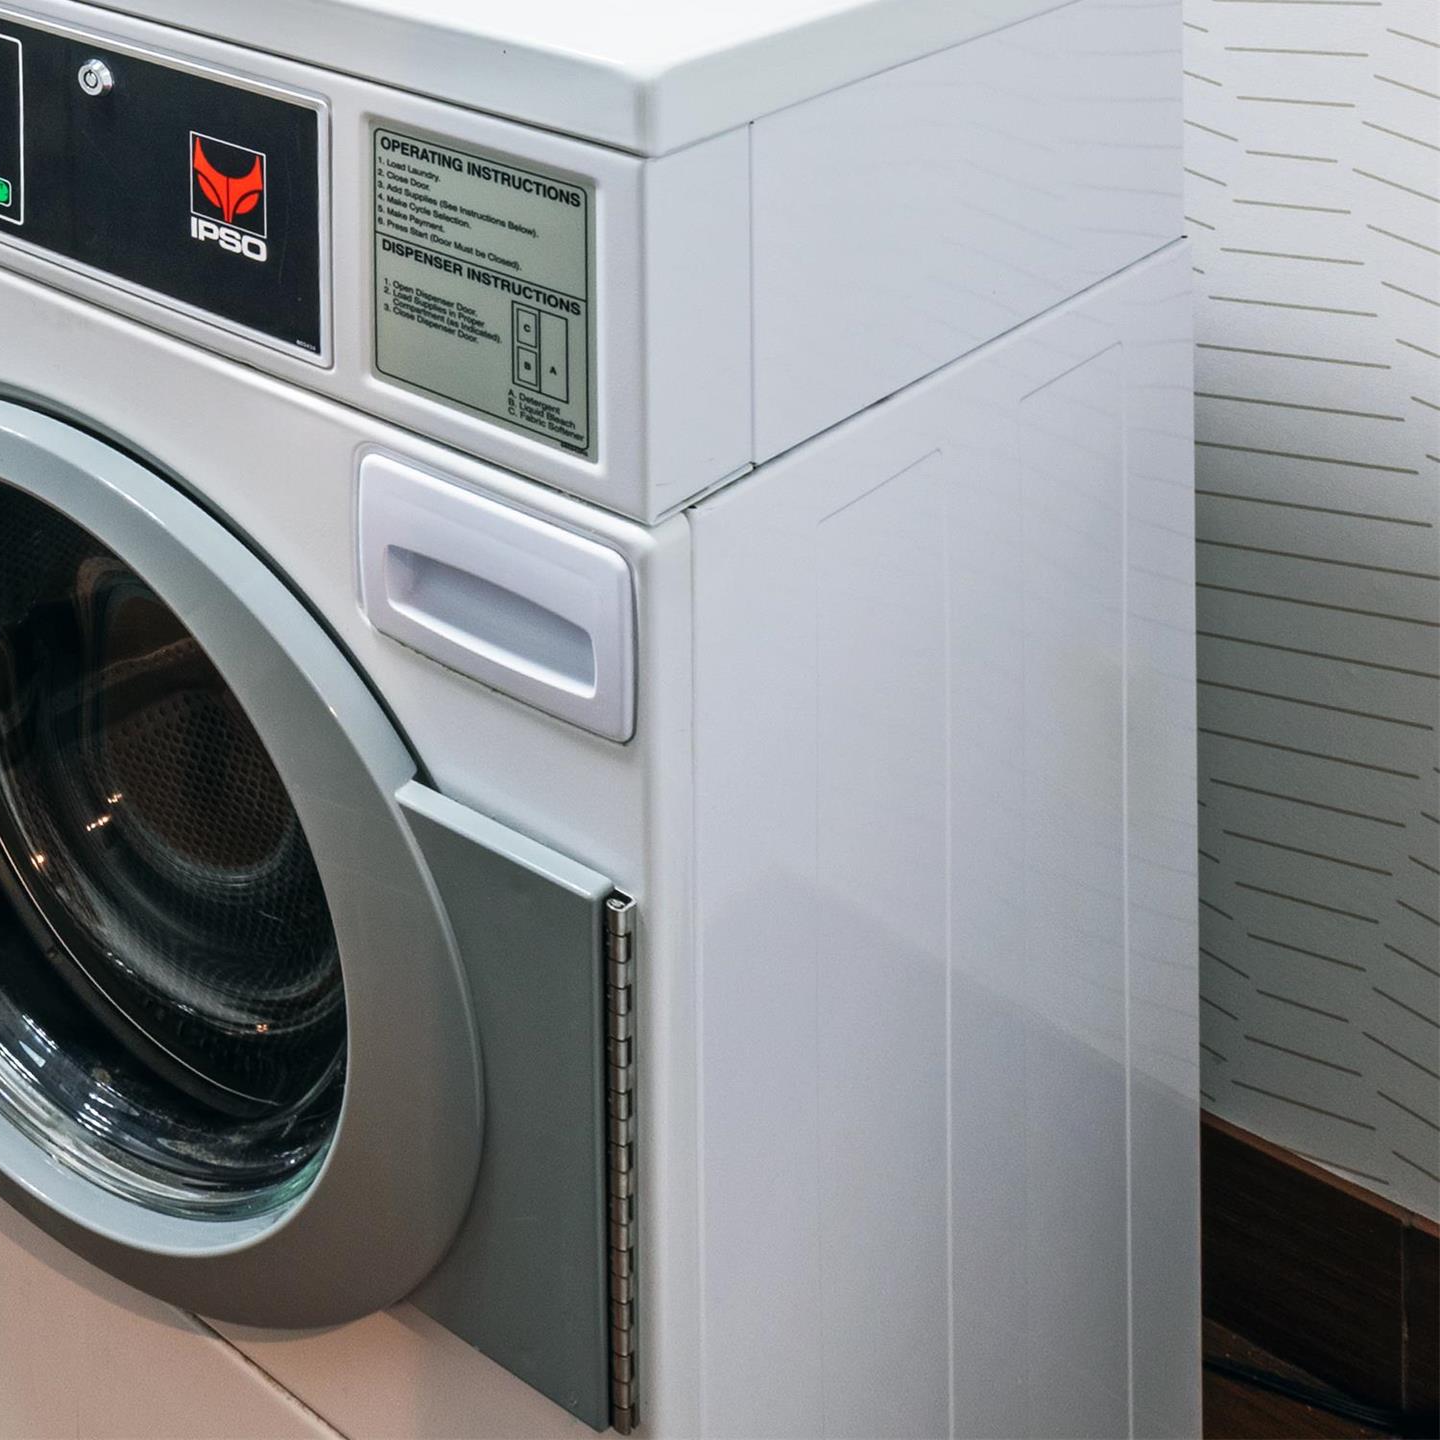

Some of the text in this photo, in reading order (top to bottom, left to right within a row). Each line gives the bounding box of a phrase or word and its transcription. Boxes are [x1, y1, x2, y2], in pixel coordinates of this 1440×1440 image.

[381, 136, 581, 207] OPERATING INSTRUCTIONS
[386, 159, 406, 171] Load
[407, 165, 441, 182] Laundry.
[386, 171, 408, 184] Close
[410, 178, 431, 191] Door.
[386, 195, 408, 208] Make
[409, 202, 431, 216] Cycle
[432, 210, 472, 229] Selection.
[386, 207, 408, 220] Make
[409, 214, 445, 233] Payment.
[387, 183, 402, 195] Add
[404, 188, 438, 206] Supplies
[439, 200, 458, 212] (See
[459, 206, 506, 228] Instructions
[508, 220, 539, 238] Below).
[191, 216, 267, 262] IPSO
[387, 219, 408, 233] Press
[410, 226, 428, 240] Start
[430, 233, 452, 247] (Door
[454, 241, 473, 255] Must
[475, 248, 486, 259] be
[487, 252, 522, 272] Closed).
[382, 238, 581, 315] DISPENSER INSTRUCTIONS
[393, 280, 414, 294] Open
[416, 288, 454, 308] Dispenser
[456, 302, 478, 317] Door.
[393, 289, 412, 303] Load
[414, 296, 447, 315] Supplies
[449, 308, 456, 318] in
[458, 311, 485, 328] Proper
[393, 298, 445, 321] Compartment
[393, 306, 415, 321] Close
[417, 315, 456, 335] Dispenser
[523, 323, 531, 332] C
[524, 361, 531, 371] B
[549, 366, 557, 375] A
[519, 392, 560, 415] Detergent
[519, 402, 544, 418] Liquid
[546, 412, 575, 430] Bleach
[520, 411, 546, 427] Fabric
[548, 422, 584, 441] Softener
